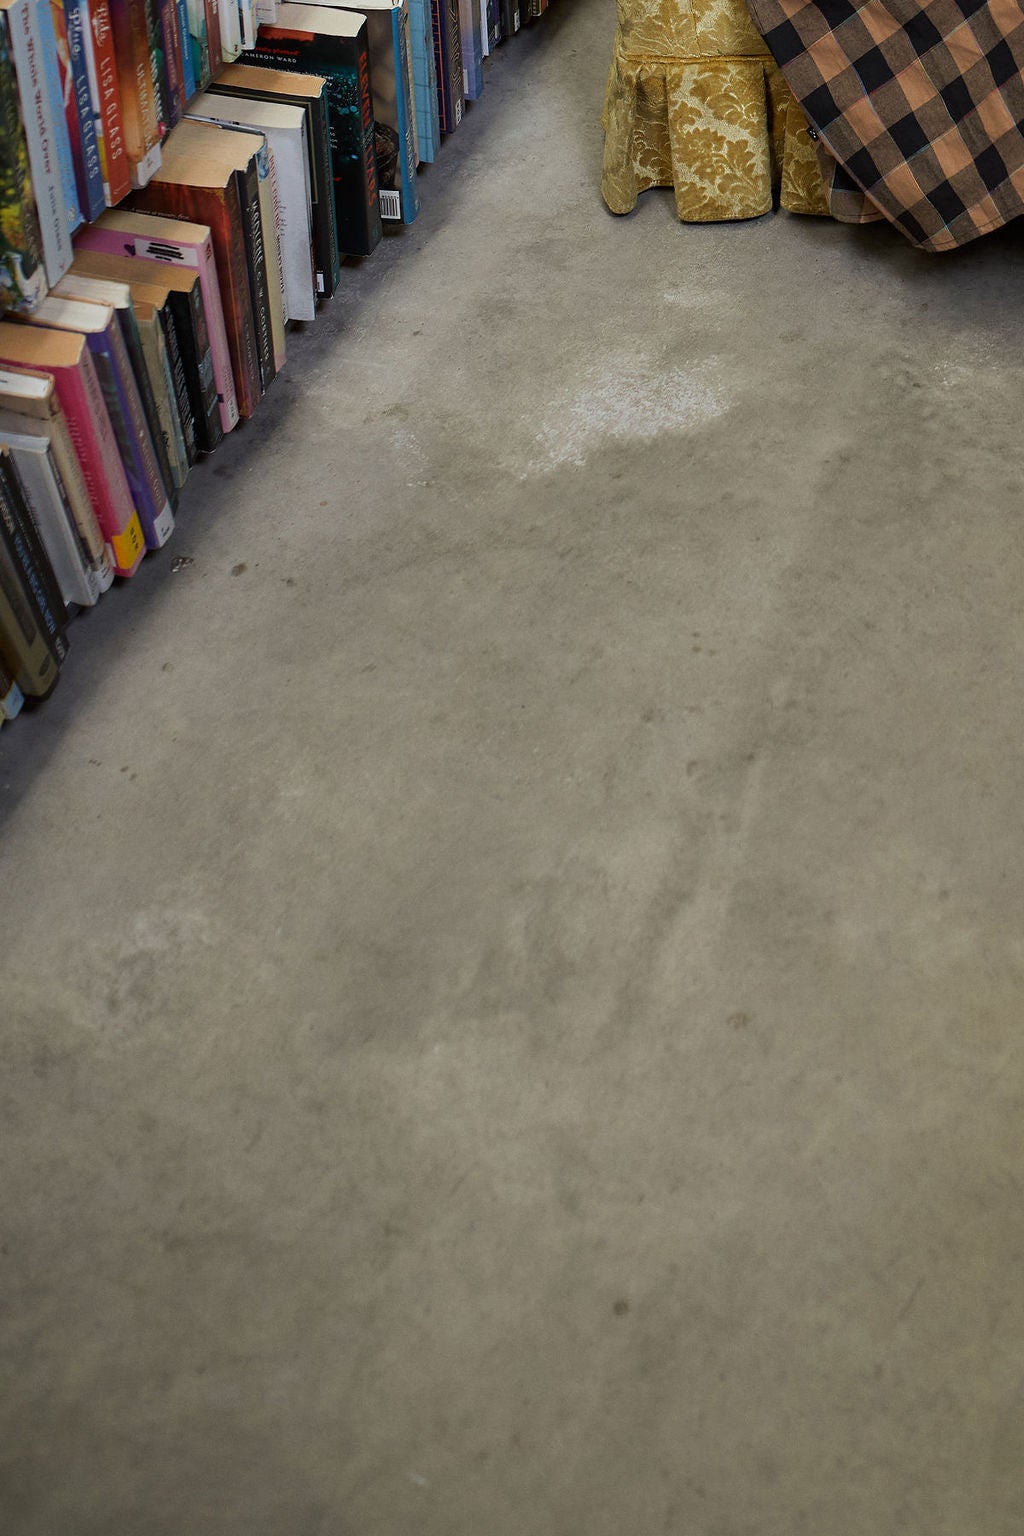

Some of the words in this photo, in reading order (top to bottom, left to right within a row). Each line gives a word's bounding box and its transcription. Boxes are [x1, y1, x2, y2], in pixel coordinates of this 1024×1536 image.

[19, 2, 32, 36] The
[25, 38, 40, 87] Whole
[99, 57, 114, 99] LISA
[276, 56, 297, 64] WARD
[75, 75, 90, 118] LISA
[136, 63, 152, 150] ULTIMATUM
[358, 51, 373, 128] ELEVEN
[30, 90, 46, 135] World
[104, 103, 123, 161] GLASS
[37, 139, 52, 176] Over
[81, 121, 99, 180] GLASS
[363, 145, 377, 208] LIARS
[46, 185, 56, 215] Julia
[52, 218, 64, 252] Glass
